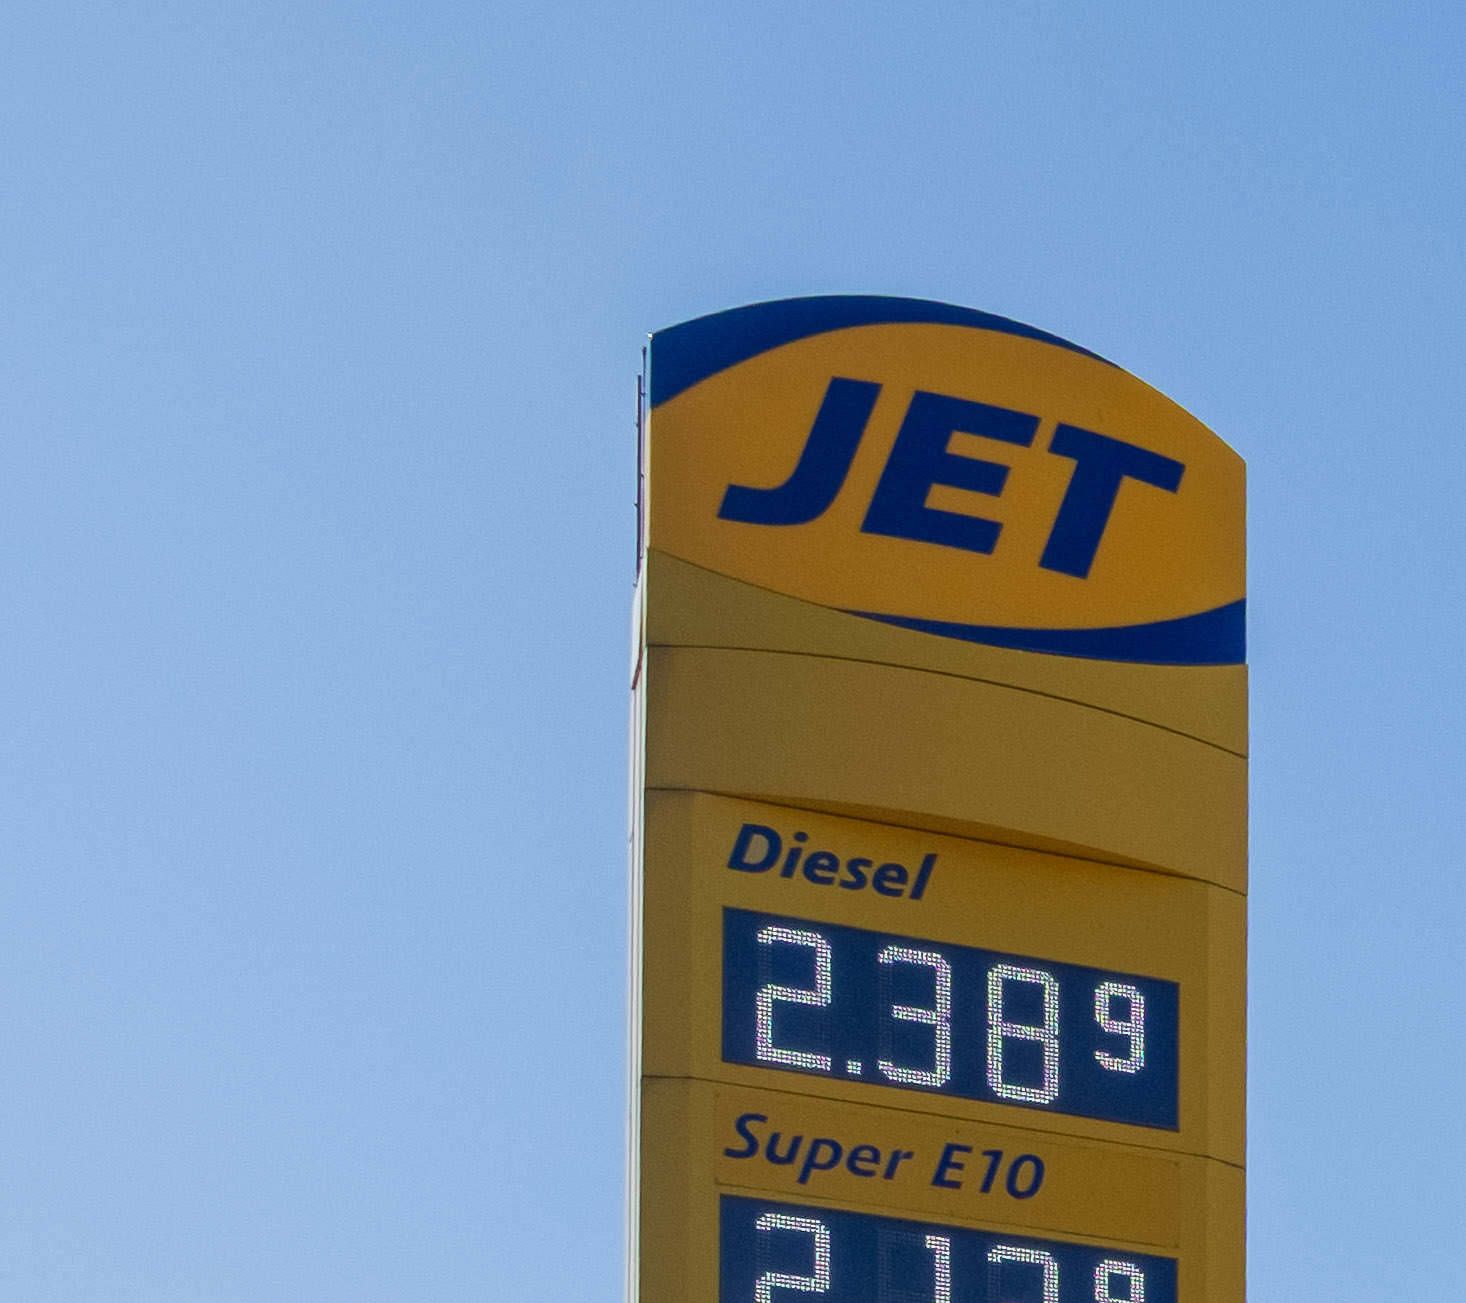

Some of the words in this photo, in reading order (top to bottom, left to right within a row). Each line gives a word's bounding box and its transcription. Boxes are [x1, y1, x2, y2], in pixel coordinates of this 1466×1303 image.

[716, 376, 1186, 580] JET
[728, 823, 940, 899] Diesel
[722, 1112, 914, 1190] Super
[931, 1139, 1046, 1201] E10
